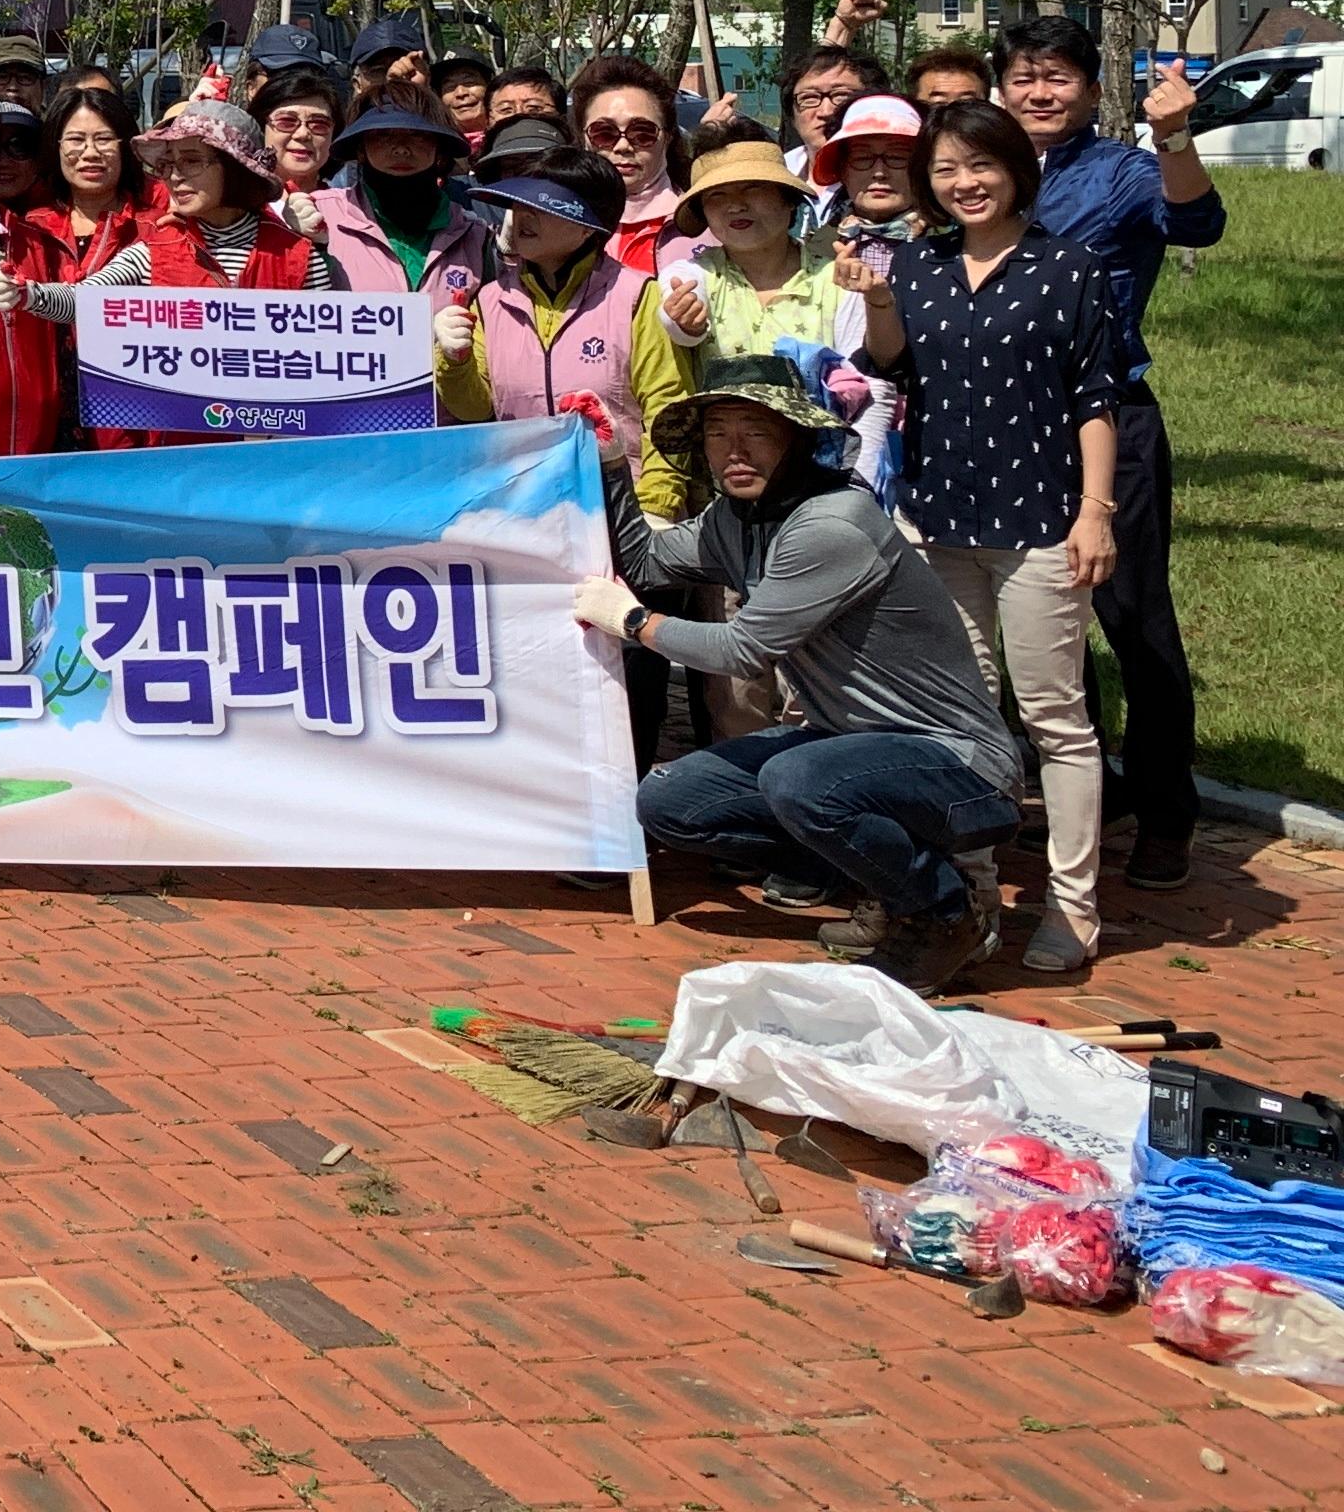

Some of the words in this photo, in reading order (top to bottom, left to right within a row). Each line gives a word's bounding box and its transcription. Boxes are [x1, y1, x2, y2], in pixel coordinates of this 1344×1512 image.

[102, 297, 256, 333] 분리배출하는
[263, 302, 343, 335] 당신의
[351, 304, 405, 336] 손이
[120, 344, 183, 378] 가장
[190, 347, 388, 384] 아름답습니다!
[237, 408, 305, 430] 양산시
[90, 562, 501, 731] 캠페인
